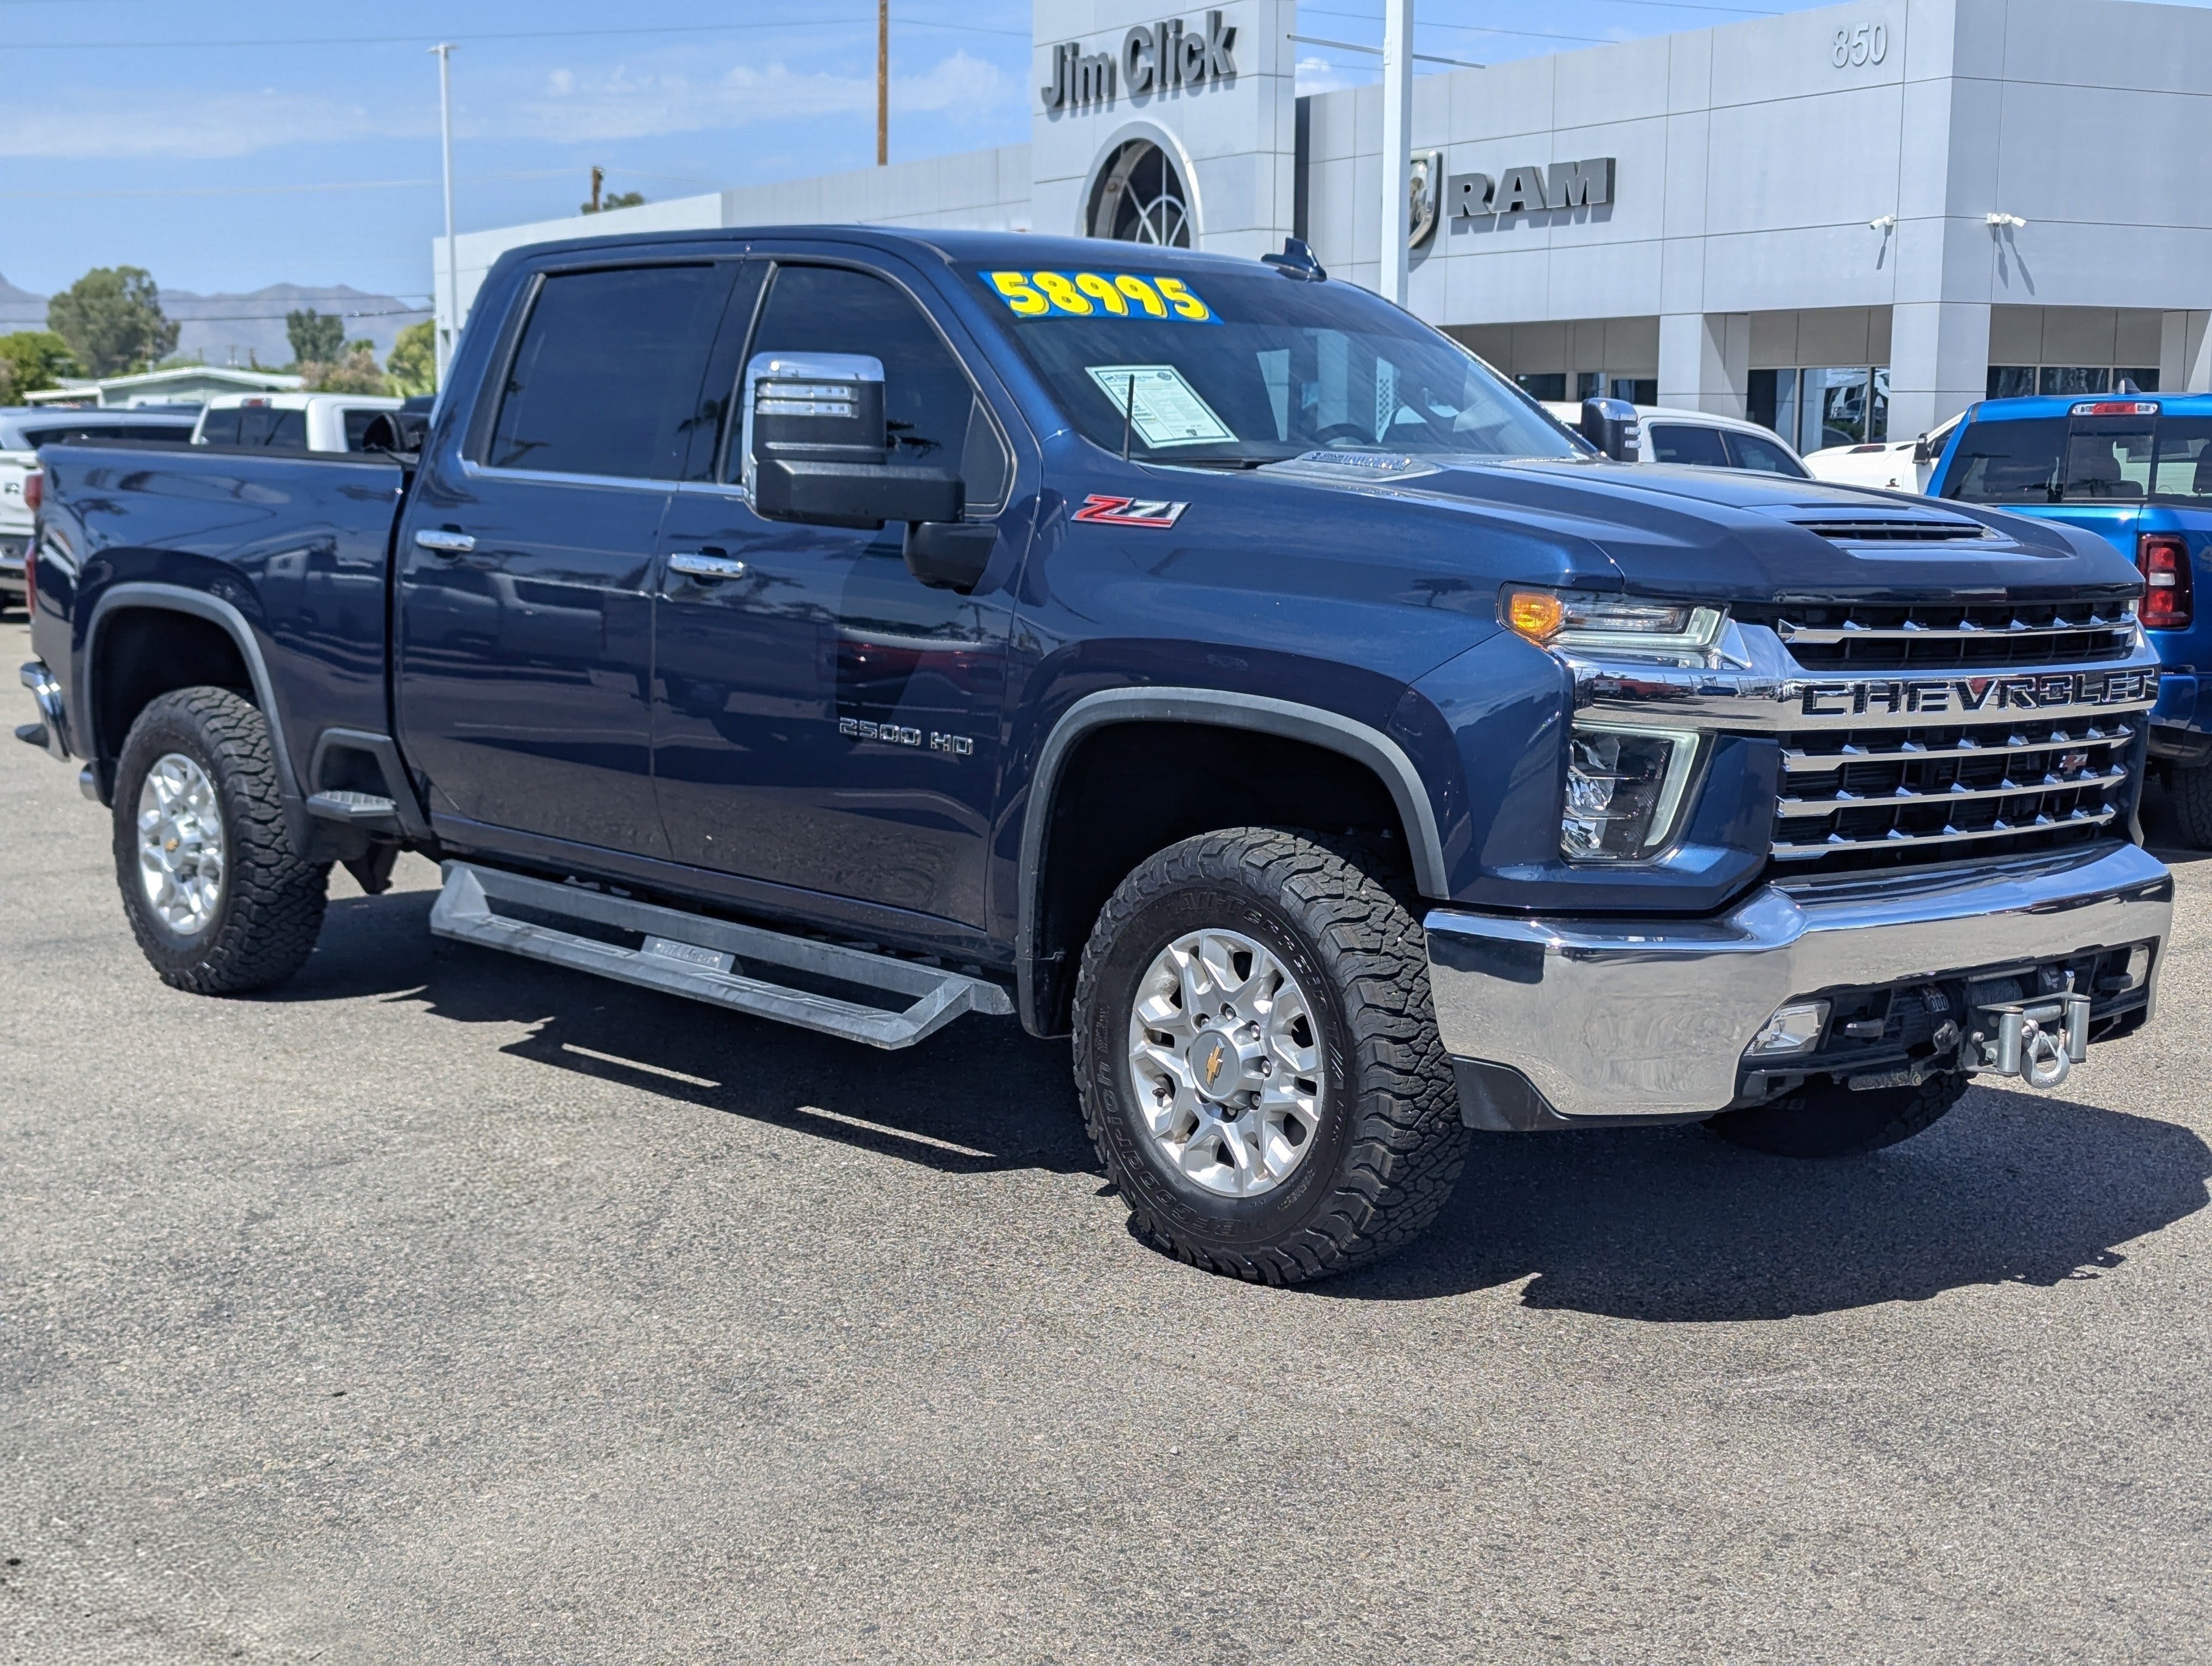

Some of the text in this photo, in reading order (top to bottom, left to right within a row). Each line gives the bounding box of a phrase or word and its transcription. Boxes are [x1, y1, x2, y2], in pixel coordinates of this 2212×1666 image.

[1041, 10, 1237, 108] Jim Click
[1831, 22, 1887, 68] 850
[1447, 157, 1616, 216] RAM
[991, 271, 1210, 321] 58995
[1070, 494, 1192, 529] Z71
[1801, 668, 2155, 716] CHEVROLET
[839, 716, 974, 755] 2500 HD
